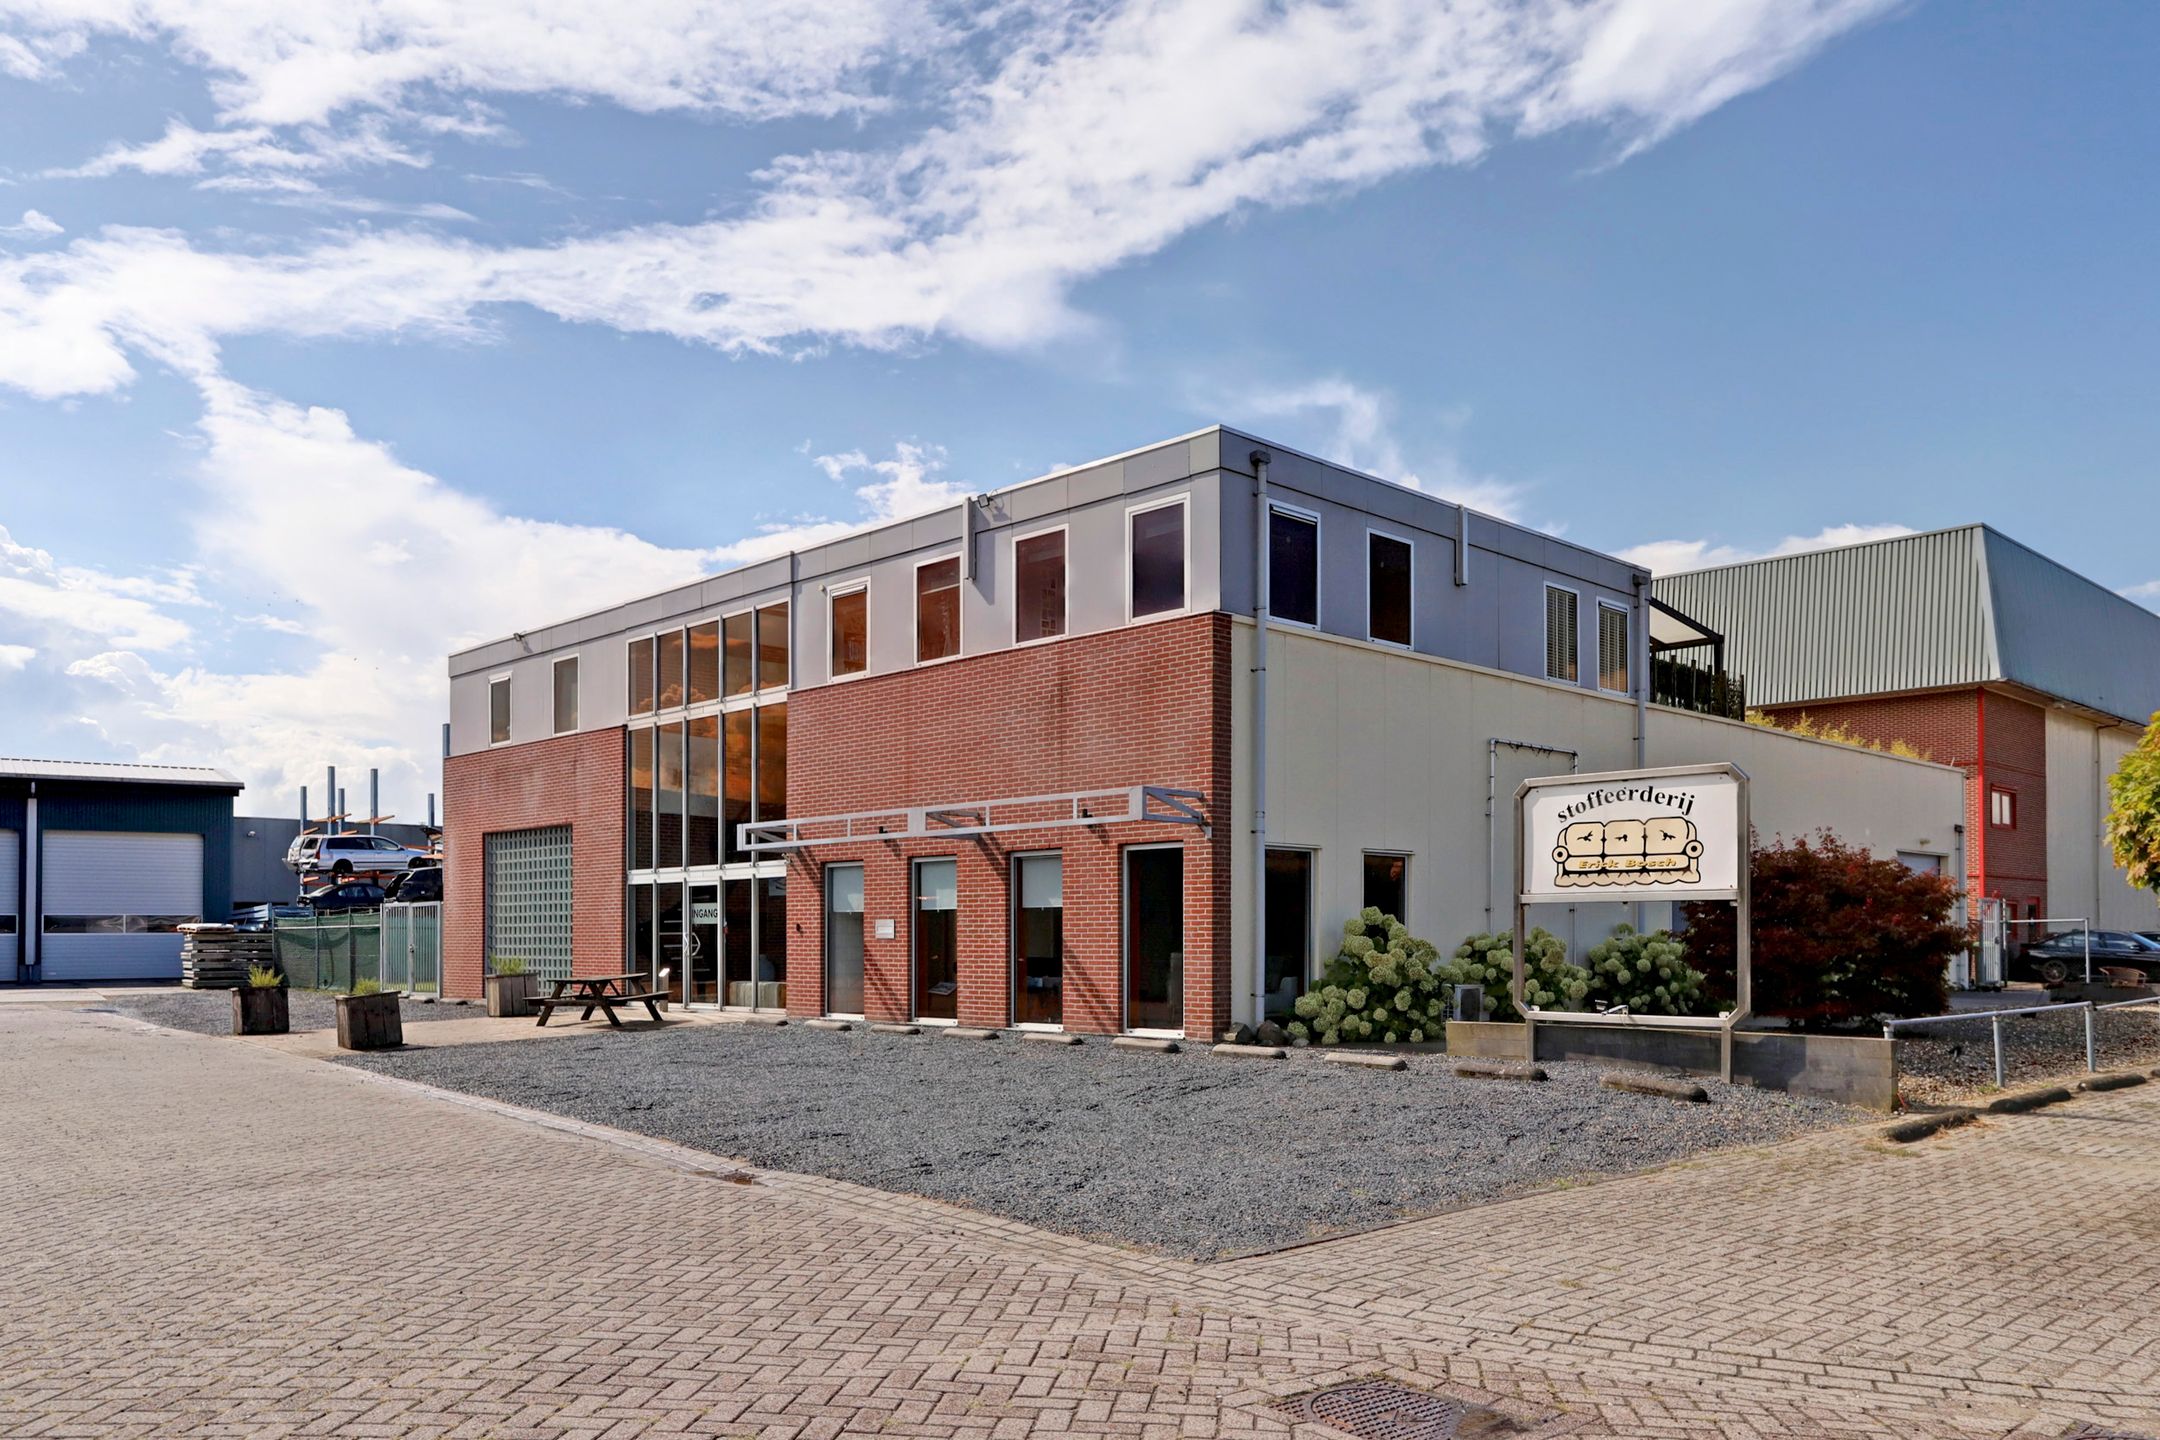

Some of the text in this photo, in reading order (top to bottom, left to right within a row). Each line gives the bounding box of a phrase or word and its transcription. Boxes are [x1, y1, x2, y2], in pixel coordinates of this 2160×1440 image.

[1557, 785, 1695, 823] stoffeerderij
[1578, 858, 1677, 869] Erick Bosch
[691, 908, 718, 919] INGANG
